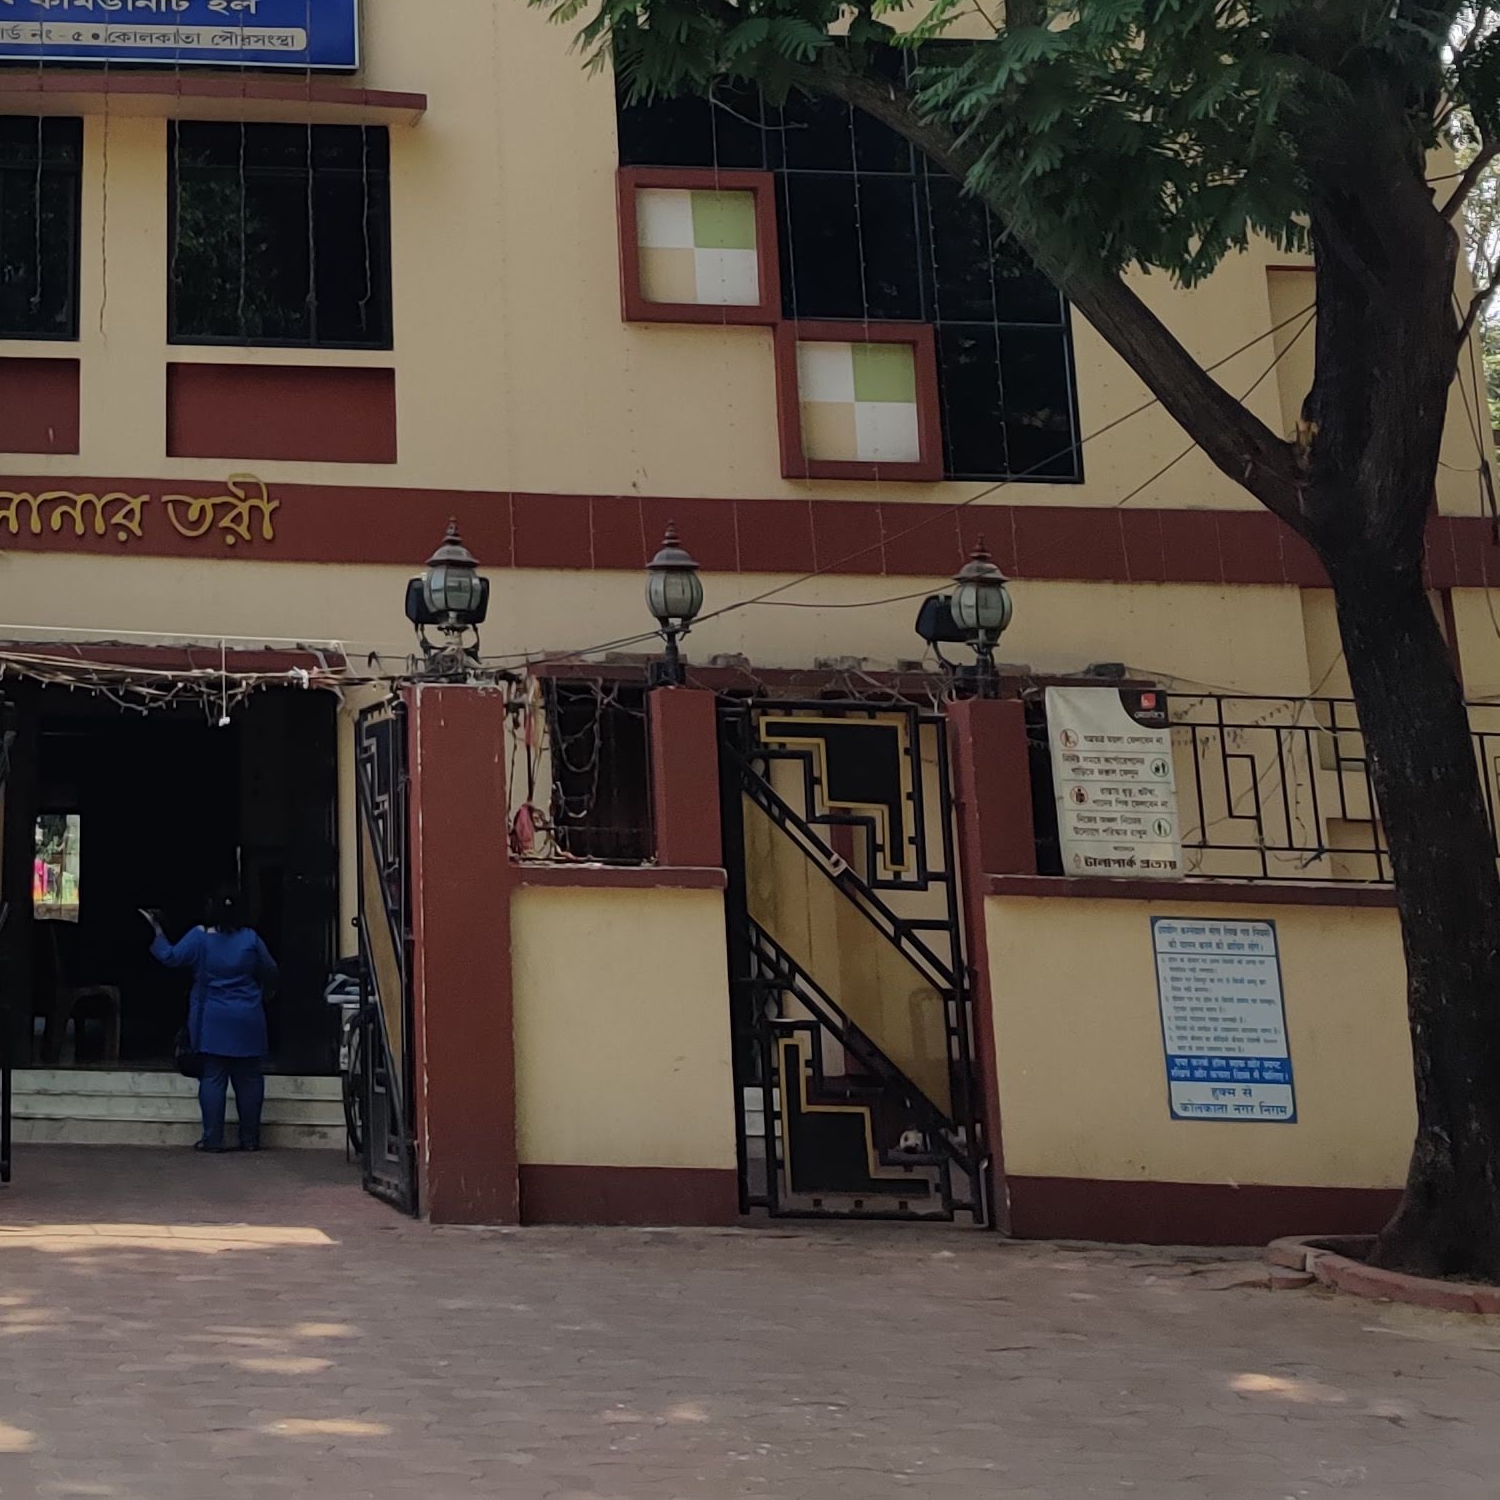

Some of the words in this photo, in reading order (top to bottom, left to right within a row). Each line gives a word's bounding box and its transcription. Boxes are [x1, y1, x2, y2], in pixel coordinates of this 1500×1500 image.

[108, 29, 200, 46] কোলকাতা
[210, 28, 295, 48] পৌরসংস্থা
[161, 472, 280, 545] তরী
[1179, 1098, 1228, 1113] कोलकाता
[1232, 1104, 1257, 1114] नगर
[1259, 1101, 1288, 1116] निगम
